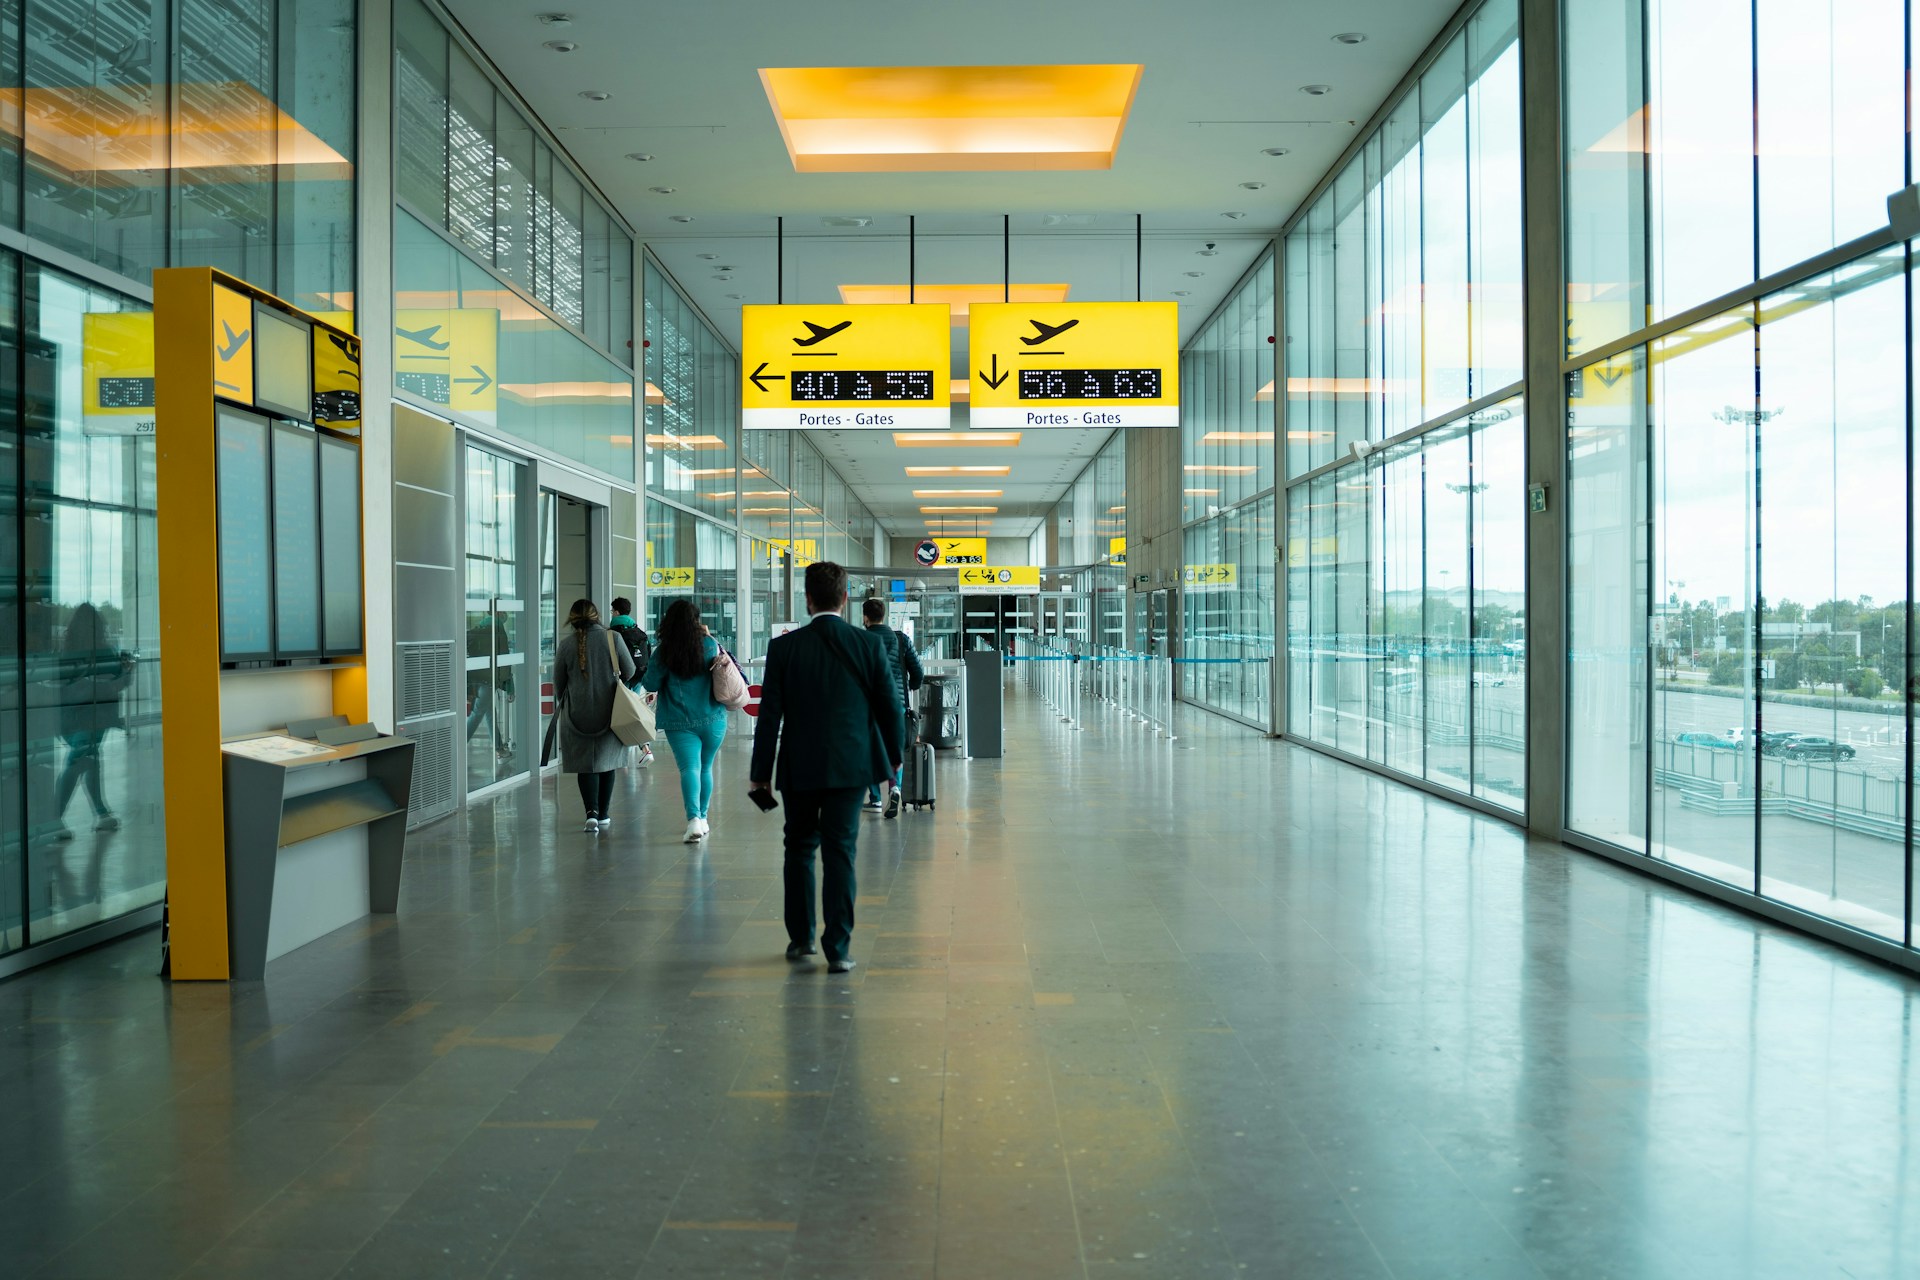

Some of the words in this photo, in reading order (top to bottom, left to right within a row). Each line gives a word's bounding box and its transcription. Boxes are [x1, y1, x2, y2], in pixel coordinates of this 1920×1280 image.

[796, 372, 839, 400] 40
[852, 372, 872, 400] à
[886, 372, 928, 399] 55
[1024, 370, 1066, 398] 56
[1080, 370, 1100, 398] à
[1114, 370, 1156, 398] 63
[799, 413, 842, 426] Portes
[855, 413, 894, 426] Gates
[1027, 412, 1069, 425] Portes
[1082, 412, 1121, 425] Gates
[946, 556, 958, 564] 56
[969, 556, 982, 564] 63
